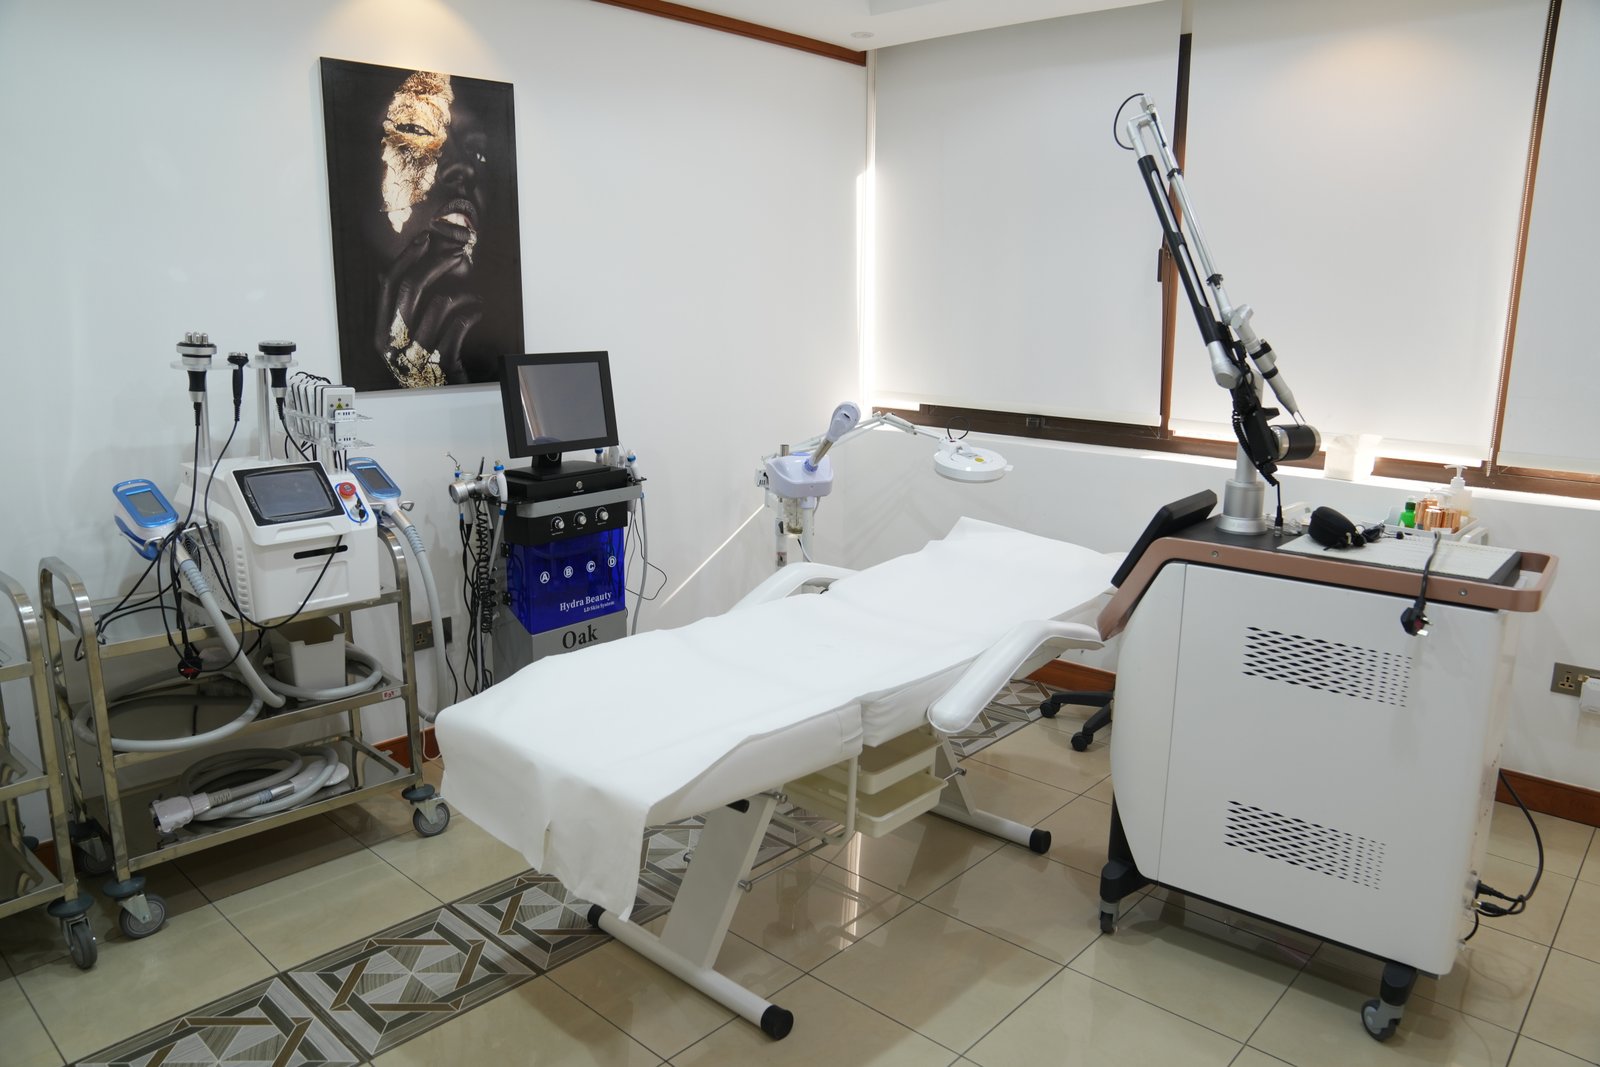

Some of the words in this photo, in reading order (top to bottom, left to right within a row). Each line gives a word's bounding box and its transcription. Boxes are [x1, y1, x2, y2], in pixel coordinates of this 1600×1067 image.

[560, 600, 584, 612] Hydra
[586, 592, 612, 604] Beauty
[562, 624, 598, 649] Oak
